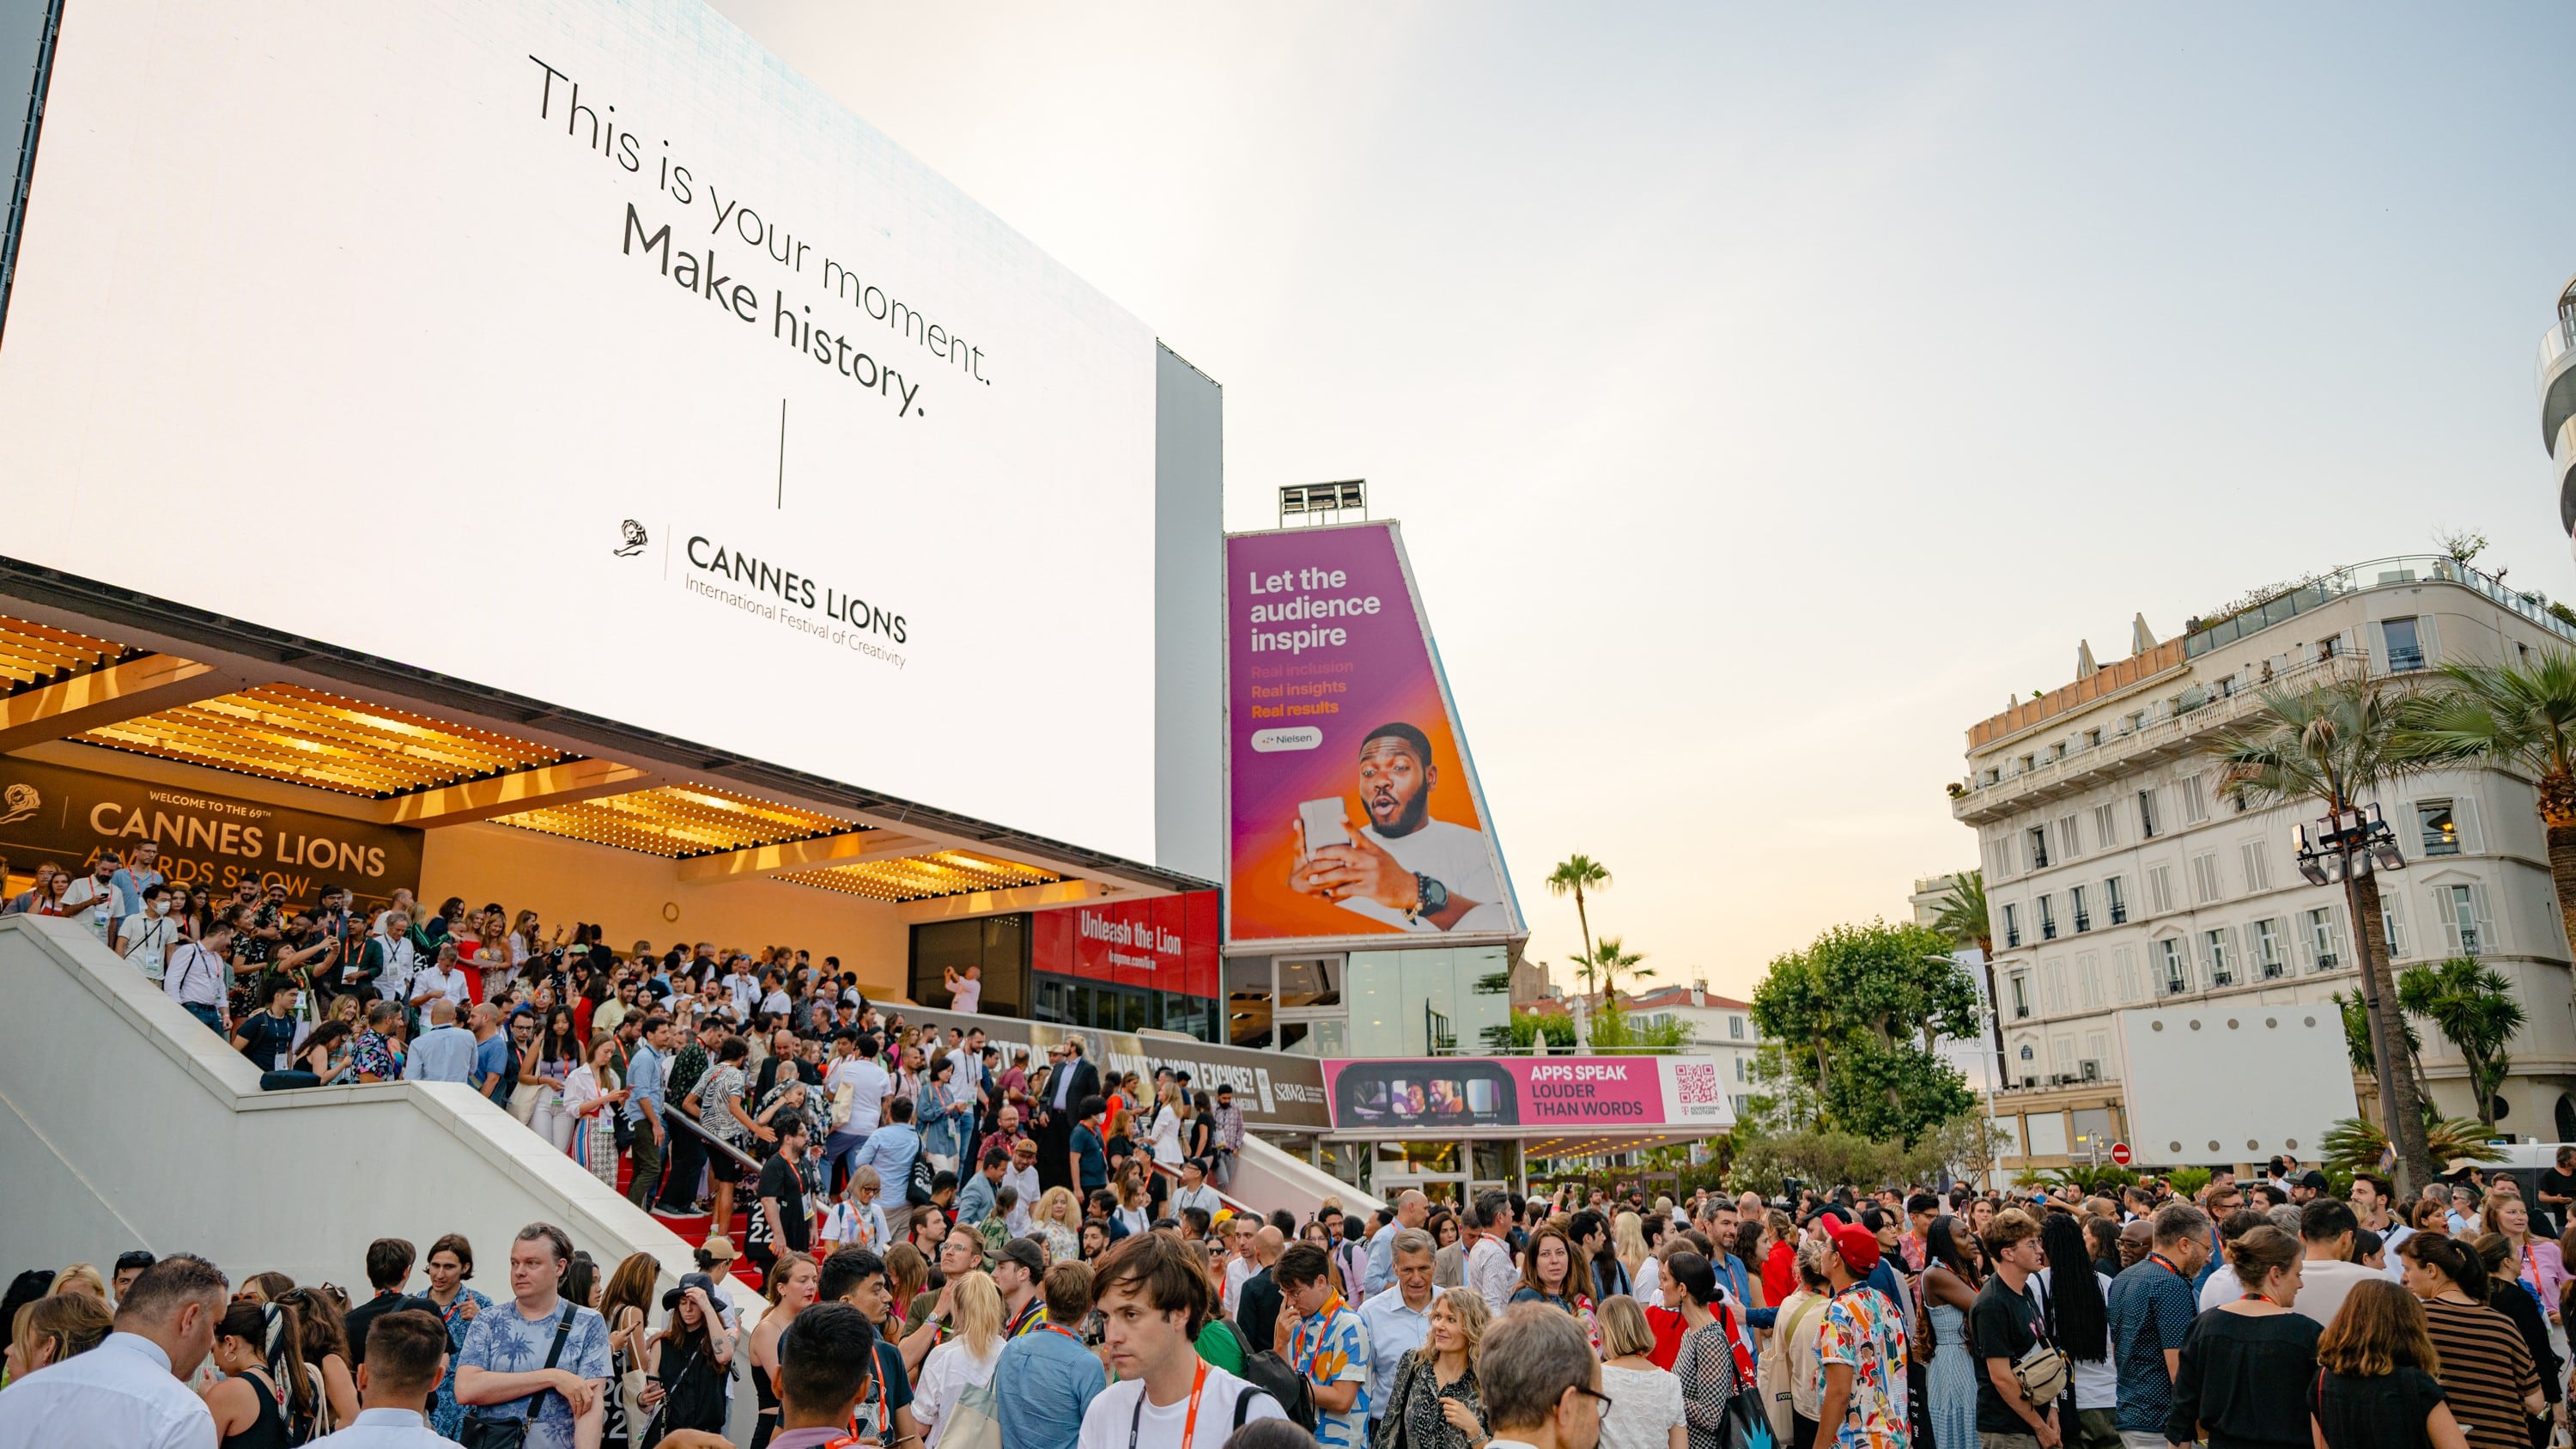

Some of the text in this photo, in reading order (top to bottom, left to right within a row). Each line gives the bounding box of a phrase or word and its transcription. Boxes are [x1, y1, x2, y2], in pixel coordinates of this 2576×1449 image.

[529, 54, 991, 387] This is your moment.
[623, 202, 924, 417] Make history.
[687, 536, 907, 644] CANNES LIONS
[1249, 567, 1347, 594] Let the
[685, 572, 907, 670] International Festival of Creativity
[1250, 594, 1381, 623] audience
[1251, 624, 1347, 654] inspire
[1251, 661, 1354, 679] Real inclusion
[1251, 679, 1347, 698] Real insights
[1251, 701, 1340, 718] Real results
[1276, 734, 1312, 745] Nielsen
[149, 791, 206, 809] WELCOME
[208, 801, 223, 812] TO
[226, 804, 246, 816] THE
[89, 802, 386, 877] CANNES LIONS
[83, 845, 310, 898] AWRDS SOW
[1081, 909, 1182, 955] Unleash the Lion
[1200, 1062, 1255, 1094] EXCUSE?
[1530, 1064, 1628, 1081] APPS SPEAK
[1532, 1084, 1595, 1099] LOUDER
[1533, 1101, 1643, 1116] THAN WORDS
